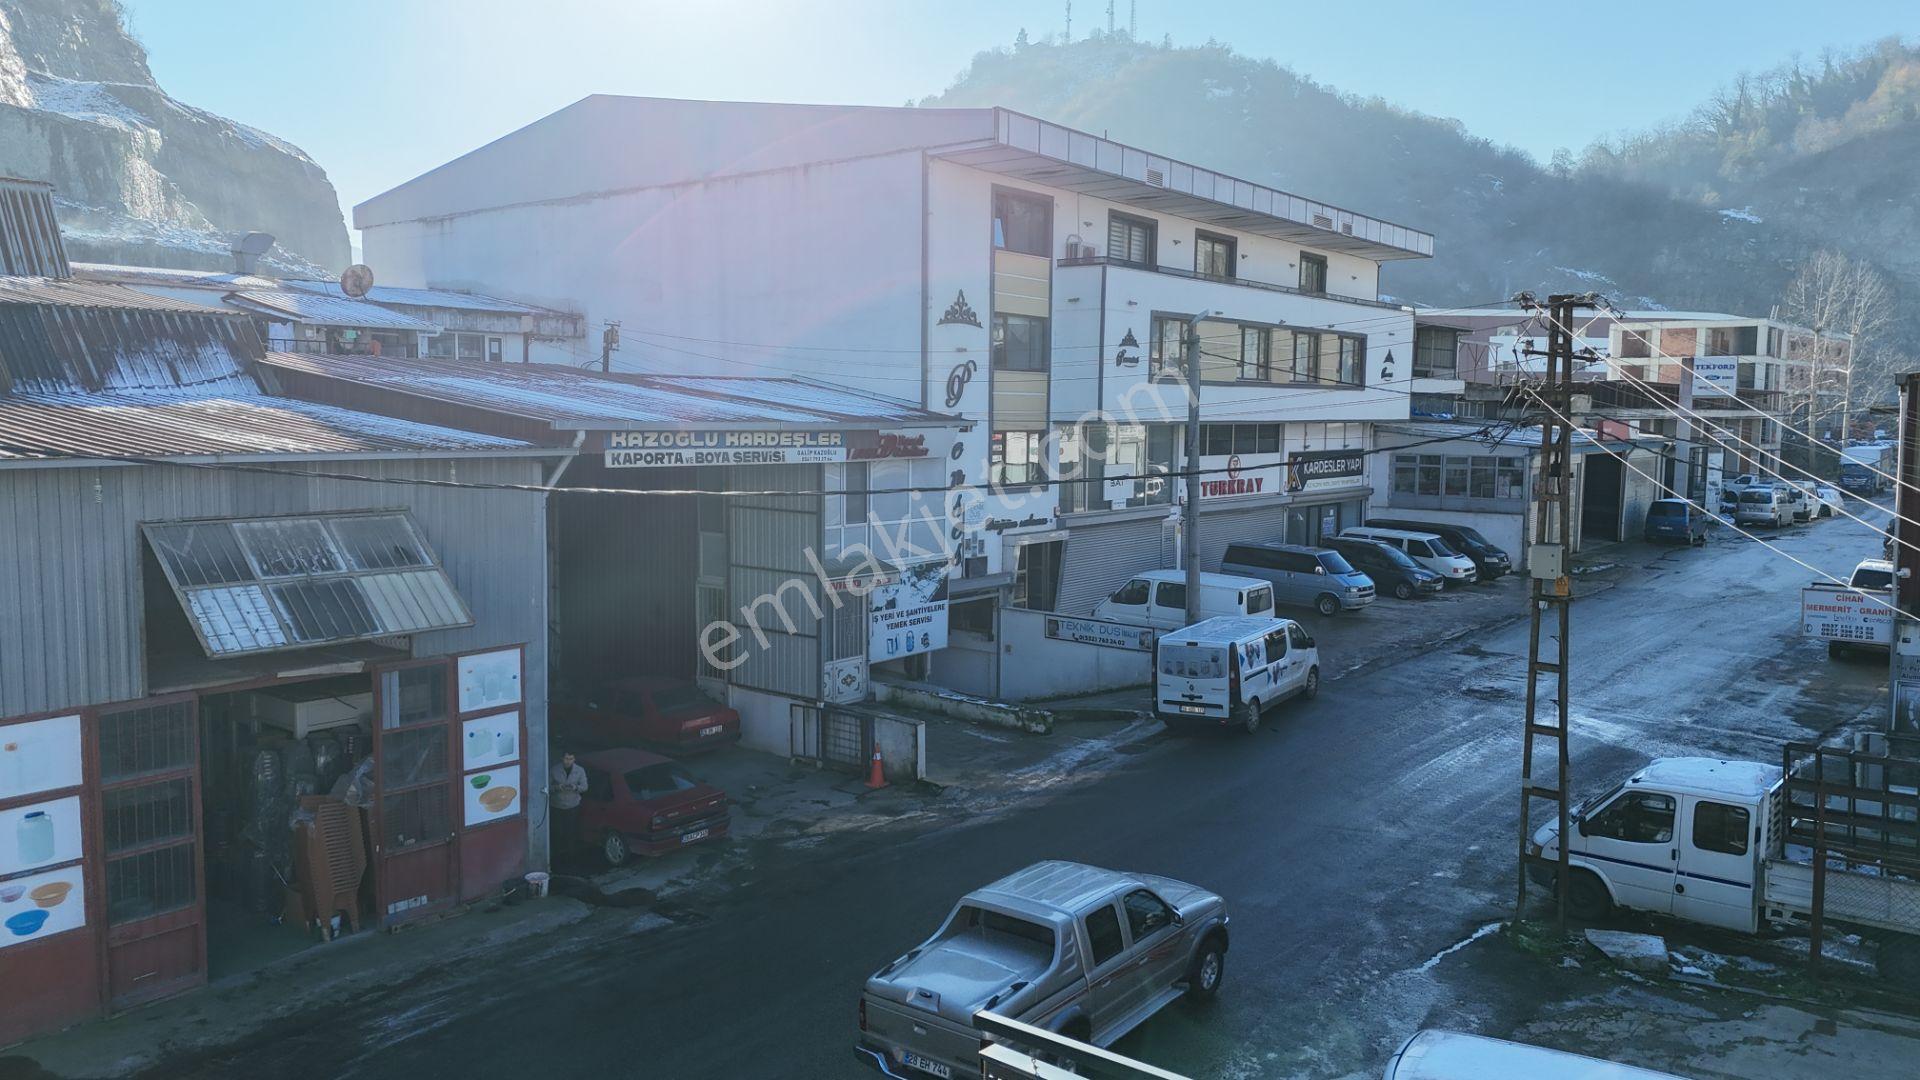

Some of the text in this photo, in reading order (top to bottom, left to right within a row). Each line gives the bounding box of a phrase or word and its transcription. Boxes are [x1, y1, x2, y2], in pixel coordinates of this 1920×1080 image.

[610, 452, 684, 466] KAPORTA
[685, 456, 694, 464] VE
[694, 451, 731, 464] BOYA
[1347, 457, 1363, 471] YAPI
[1835, 594, 1864, 603] CİHAN
[880, 608, 895, 622] YERİ
[896, 608, 905, 619] VE
[886, 615, 933, 631] YEMEK SERVİSİ
[909, 1054, 948, 1076] 28 EH 744
